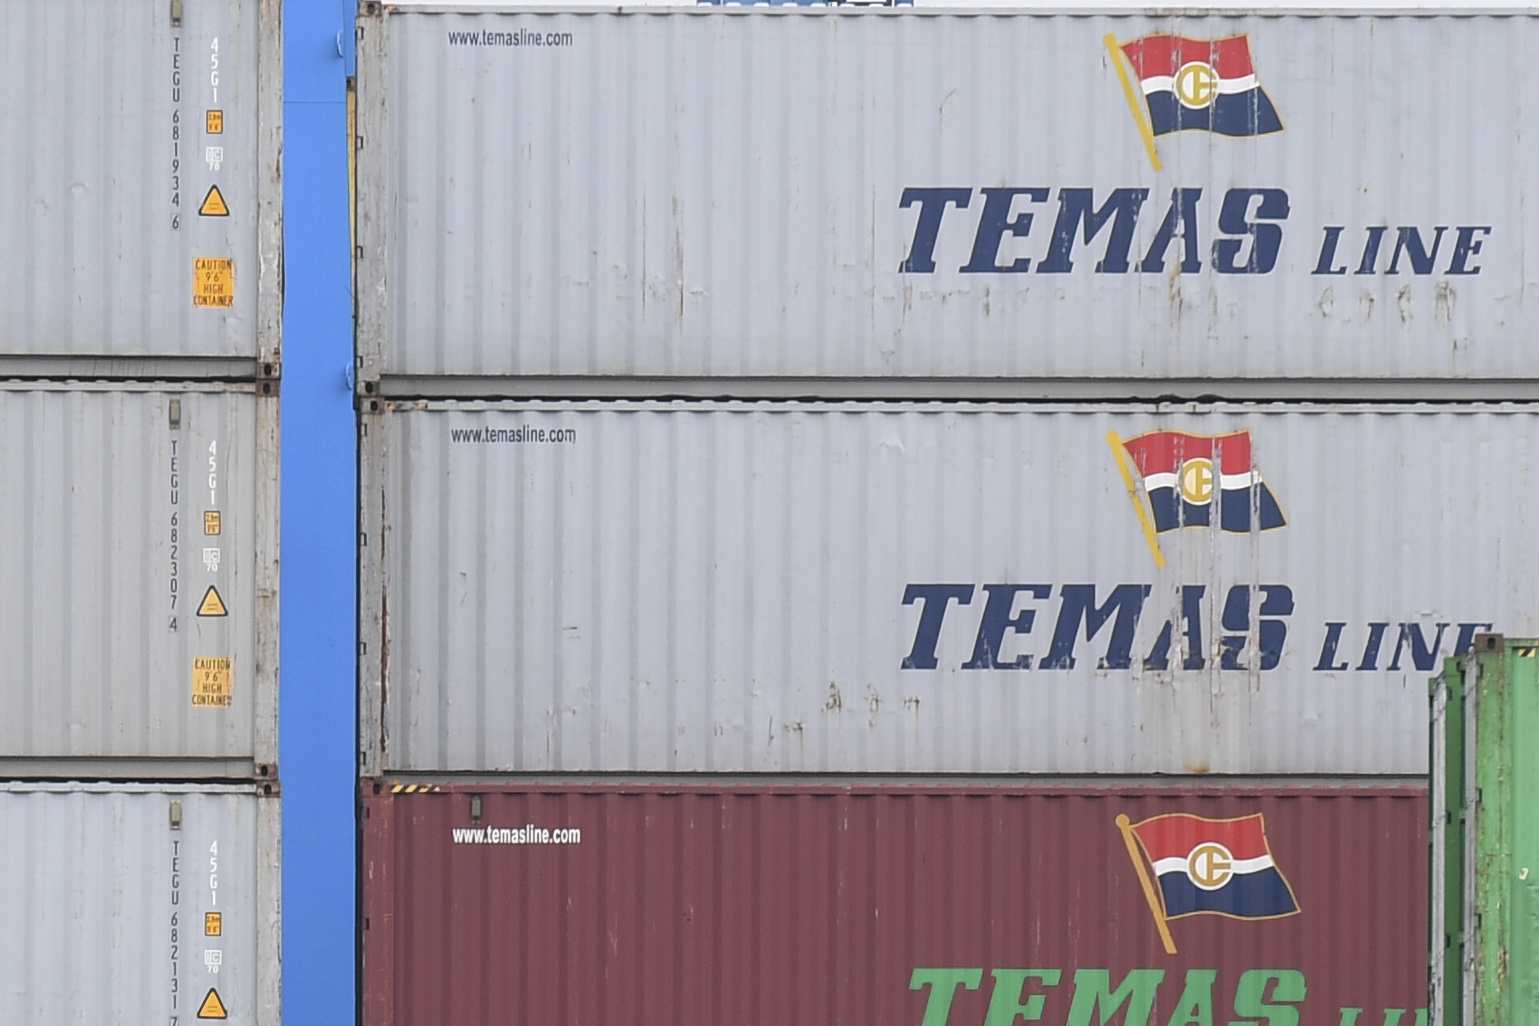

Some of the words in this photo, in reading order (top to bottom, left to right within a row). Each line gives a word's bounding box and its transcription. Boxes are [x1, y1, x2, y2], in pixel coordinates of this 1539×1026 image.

[448, 27, 573, 46] www.temasline.com
[172, 37, 180, 103] TEGU
[210, 37, 219, 103] 45G1
[172, 109, 180, 207] 681934
[209, 162, 220, 171] 70
[172, 216, 179, 230] 6
[898, 186, 1290, 275] TEMAS
[1311, 226, 1491, 275] LINE
[195, 258, 232, 270] CAUTION
[204, 283, 223, 294] HIGH
[193, 295, 233, 307] CONTAINER
[451, 424, 576, 444] www.temasline.com
[170, 440, 178, 505] TEGU
[208, 440, 217, 505] 45G1
[170, 511, 178, 610] 682307
[206, 563, 218, 572] 70
[169, 617, 177, 631] 4
[900, 583, 1295, 671] TEMAS
[194, 659, 231, 670] CAUTION
[202, 683, 222, 694] HIGH
[452, 824, 581, 844] www.temasline.com
[171, 840, 180, 905] TEGU
[209, 840, 218, 906] 45G1
[207, 965, 219, 974] 70
